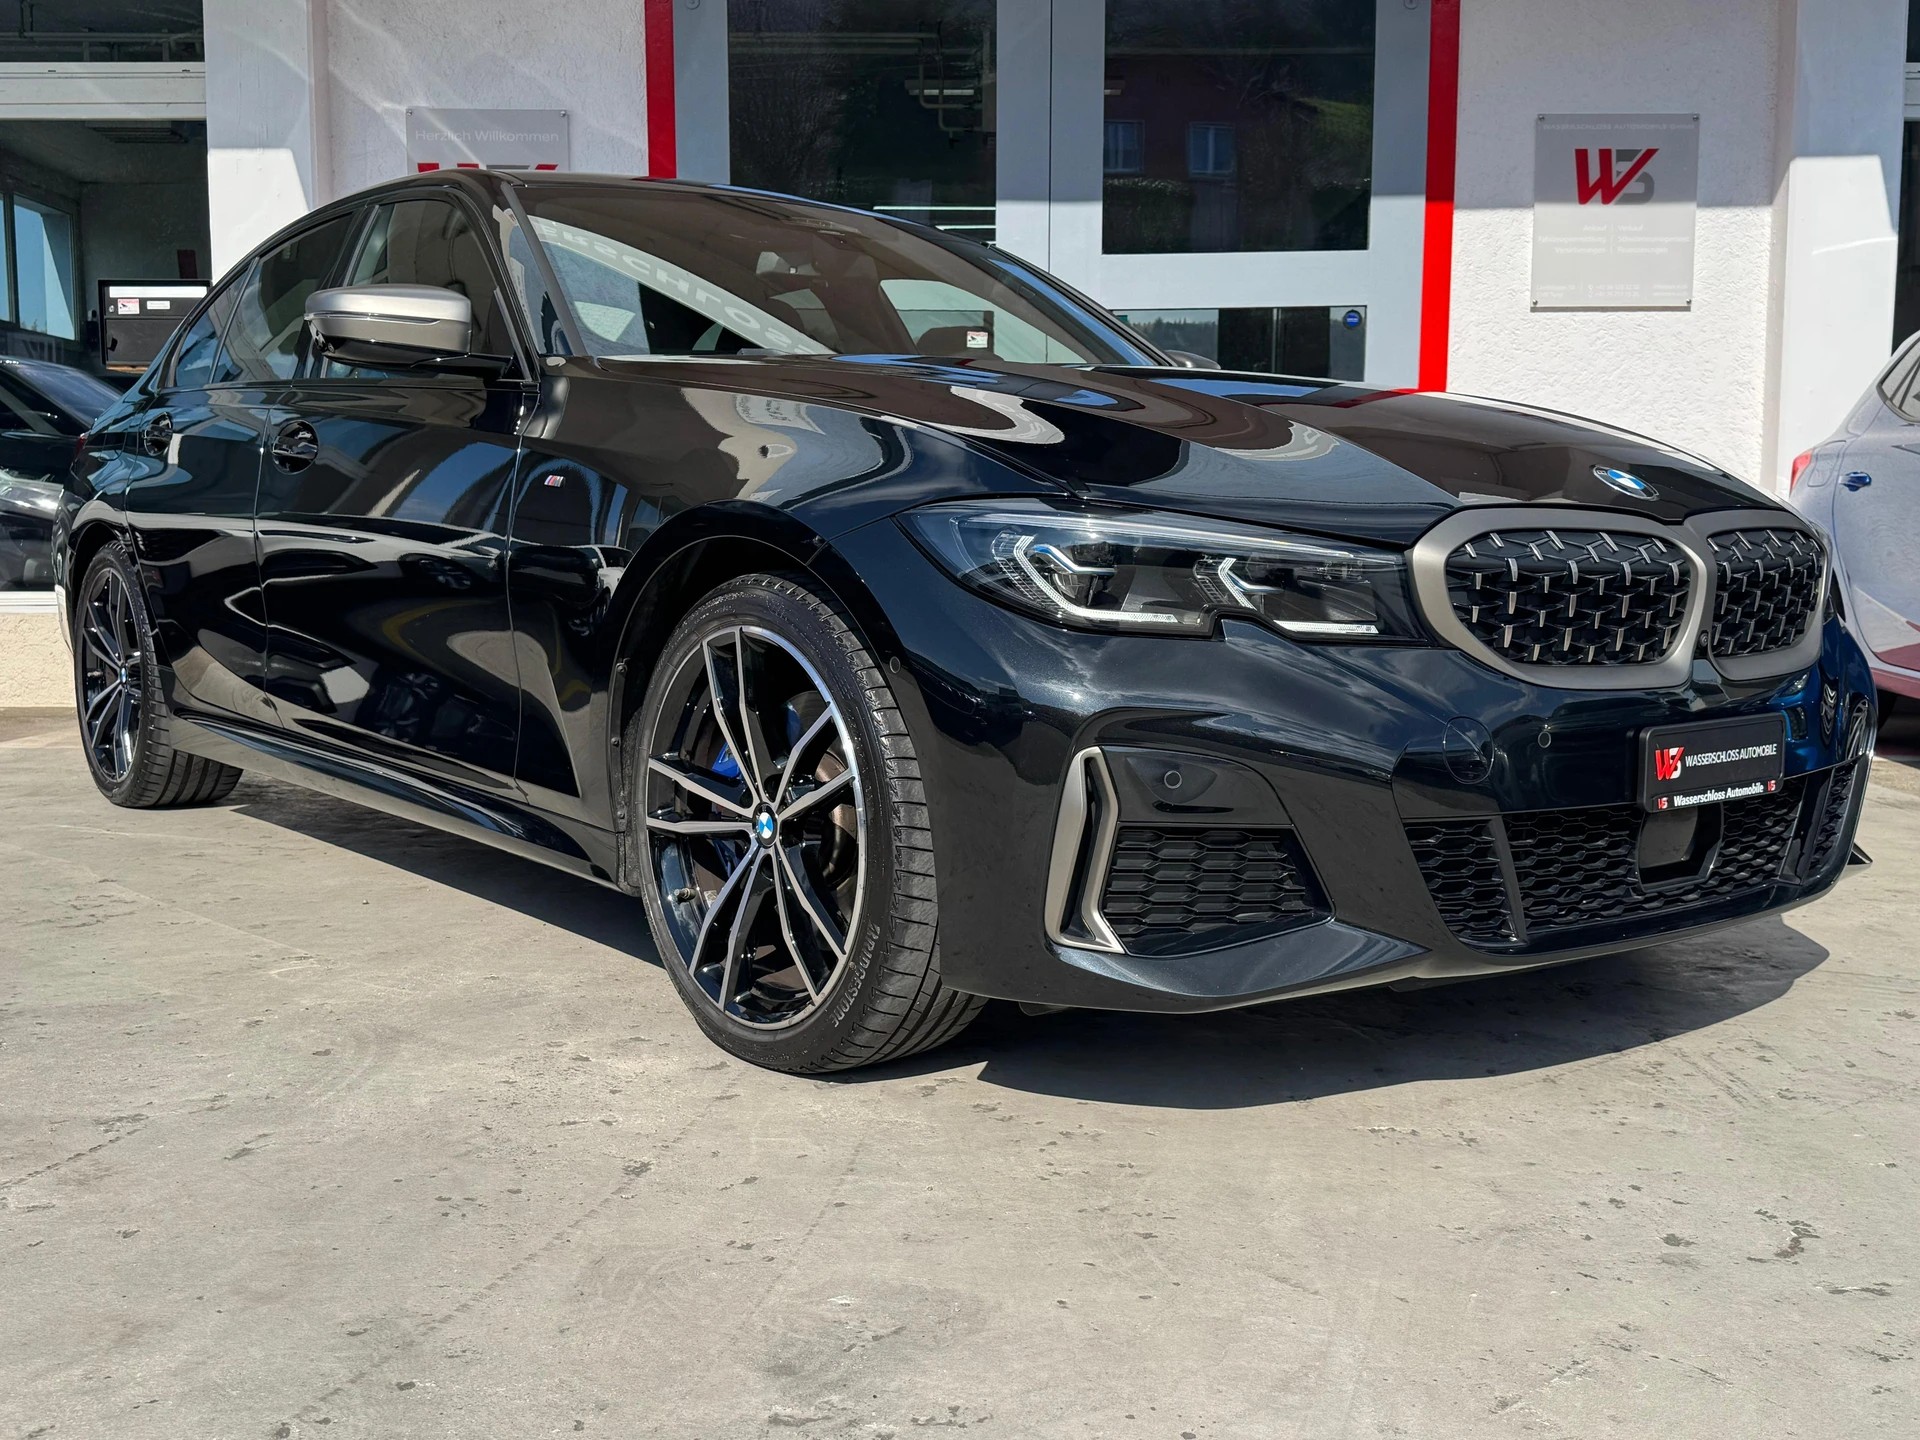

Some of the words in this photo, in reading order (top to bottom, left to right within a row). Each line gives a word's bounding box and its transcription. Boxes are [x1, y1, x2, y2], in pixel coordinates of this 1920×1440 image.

[415, 130, 471, 141] Herzlich
[474, 130, 559, 142] Willkommen
[1685, 748, 1740, 768] WASSERSCHLOSS
[1739, 743, 1777, 760] AUTOMOBILE
[1673, 789, 1726, 807] Wasserschloss
[1726, 781, 1764, 799] Automobile
